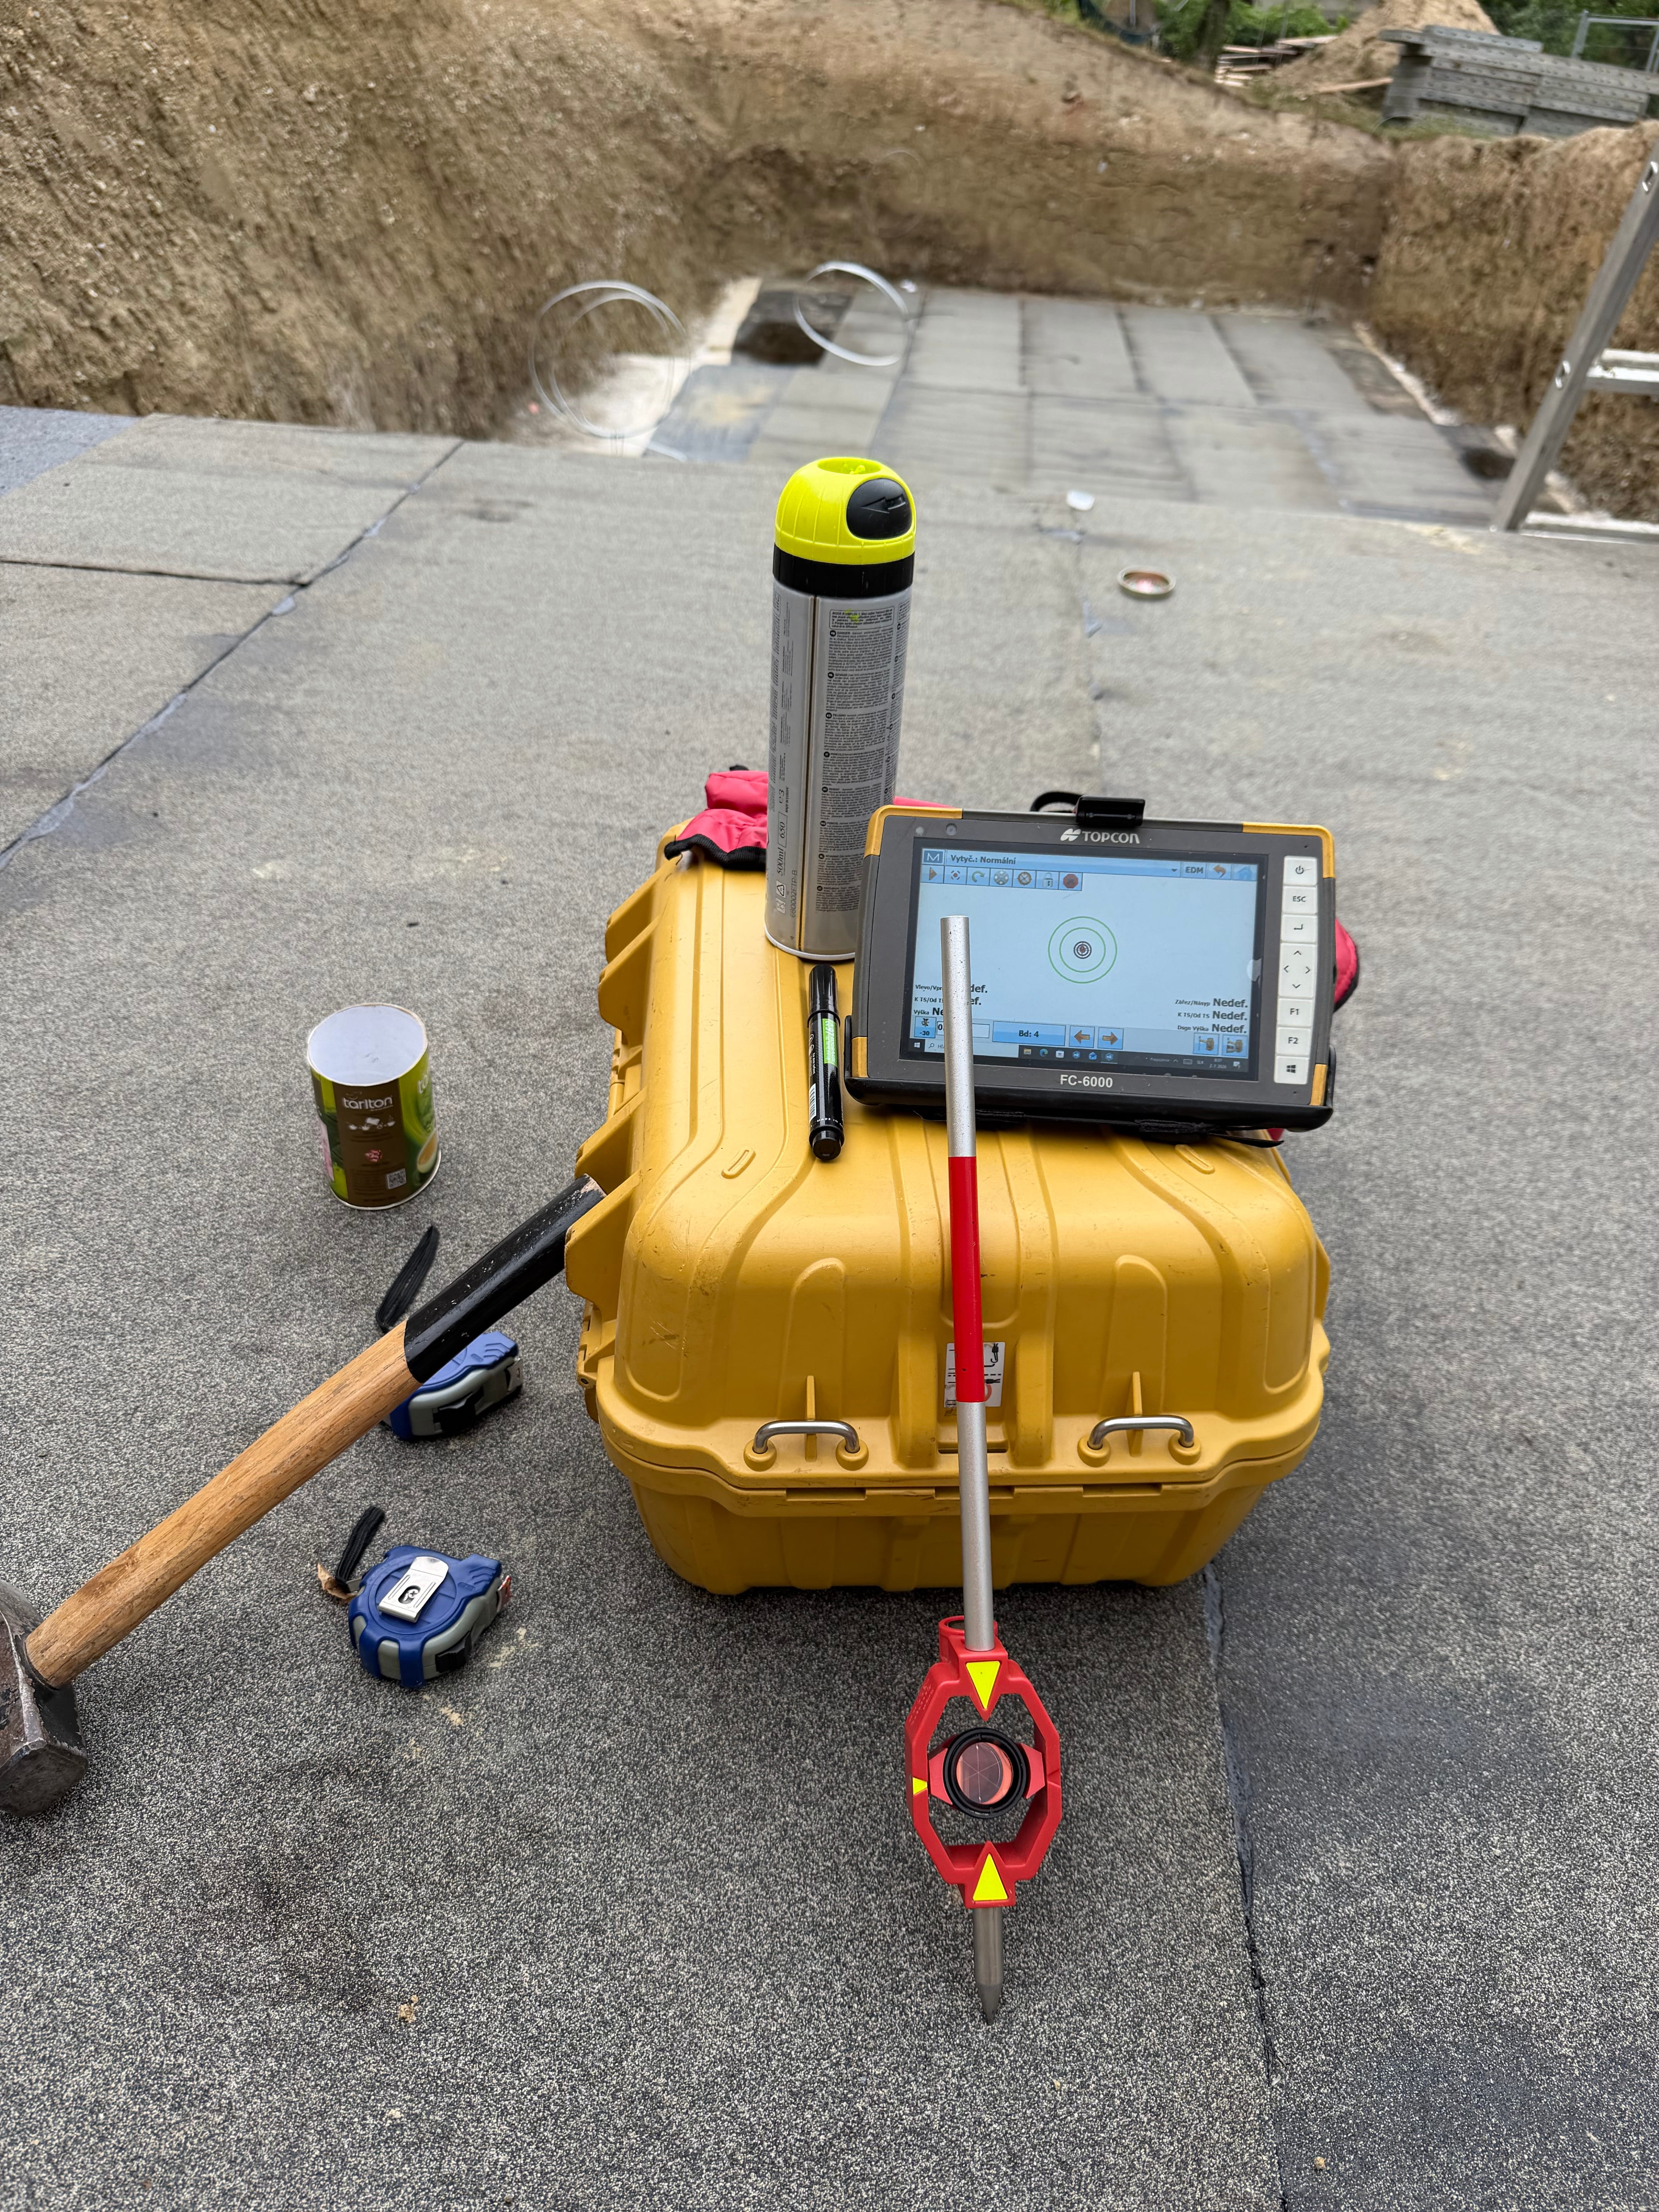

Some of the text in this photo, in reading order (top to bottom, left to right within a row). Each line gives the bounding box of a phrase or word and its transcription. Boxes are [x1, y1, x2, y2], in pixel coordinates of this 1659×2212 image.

[1082, 831, 1140, 844] TOPCON
[951, 855, 1016, 865] Vytyč.: Normální
[1213, 998, 1248, 1008] Nedef.
[1212, 1011, 1247, 1020] Nedef.
[1212, 1024, 1247, 1033] Nedef.
[1060, 1075, 1113, 1088] FC-6000
[343, 1097, 393, 1109] tarlton
